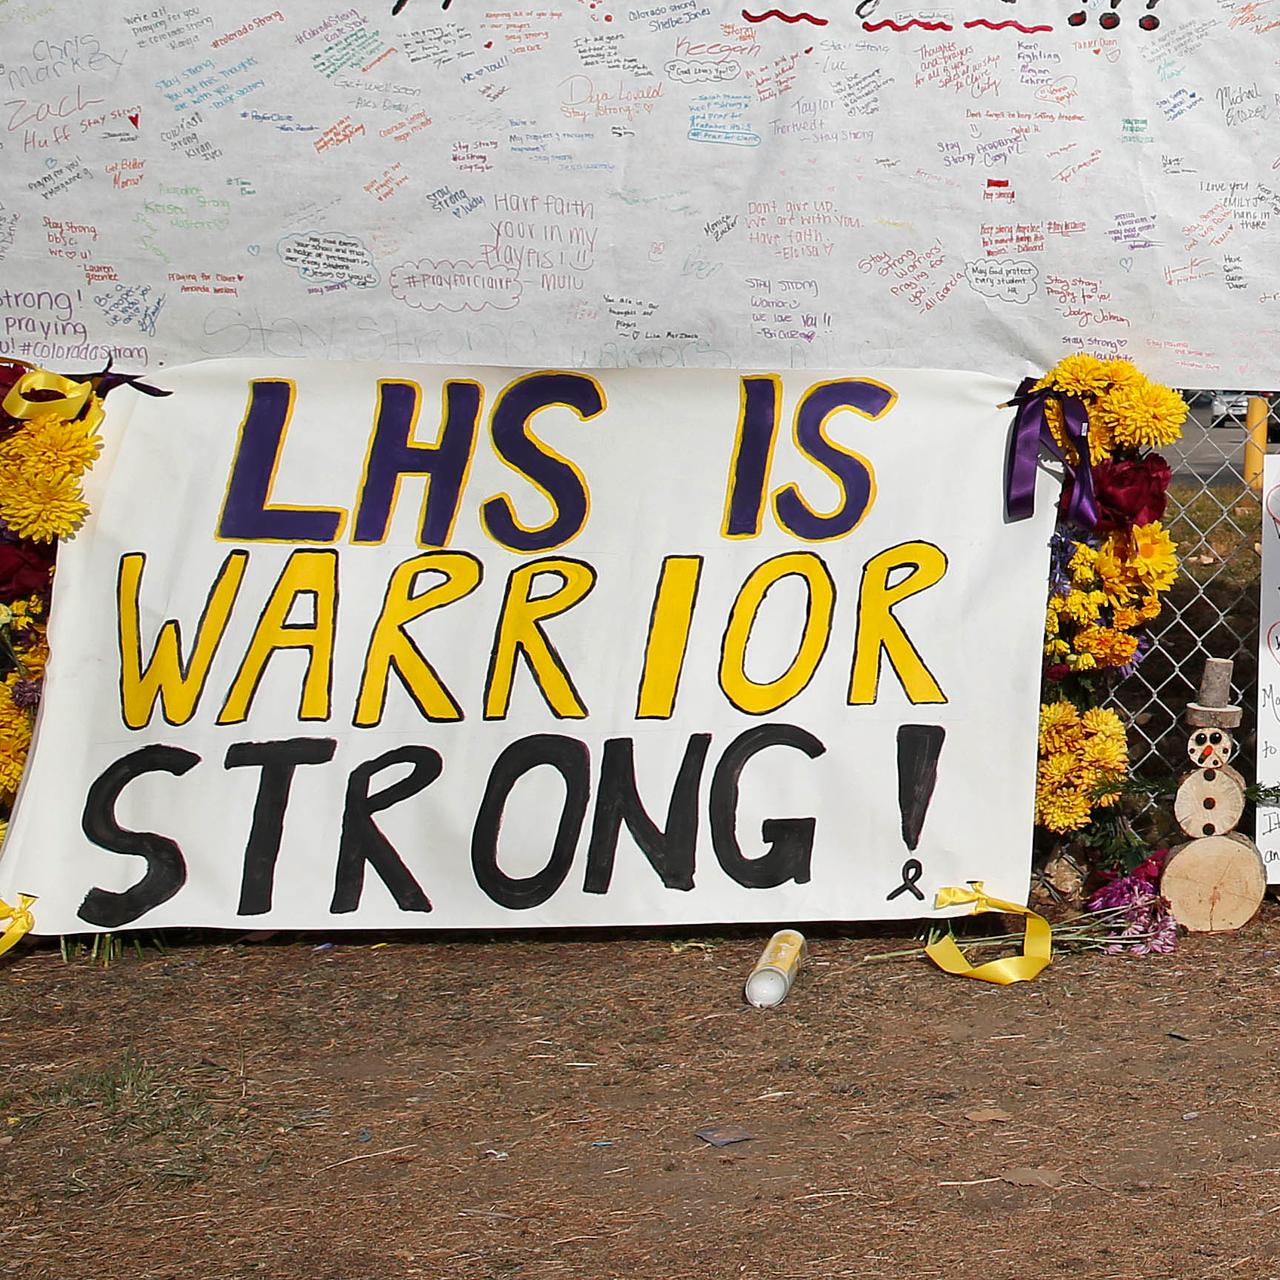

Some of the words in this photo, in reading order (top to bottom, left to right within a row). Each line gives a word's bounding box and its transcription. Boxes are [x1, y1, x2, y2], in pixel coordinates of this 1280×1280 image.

[214, 372, 608, 556] LHS
[720, 372, 898, 542] IS
[115, 539, 951, 730] WARRIOR
